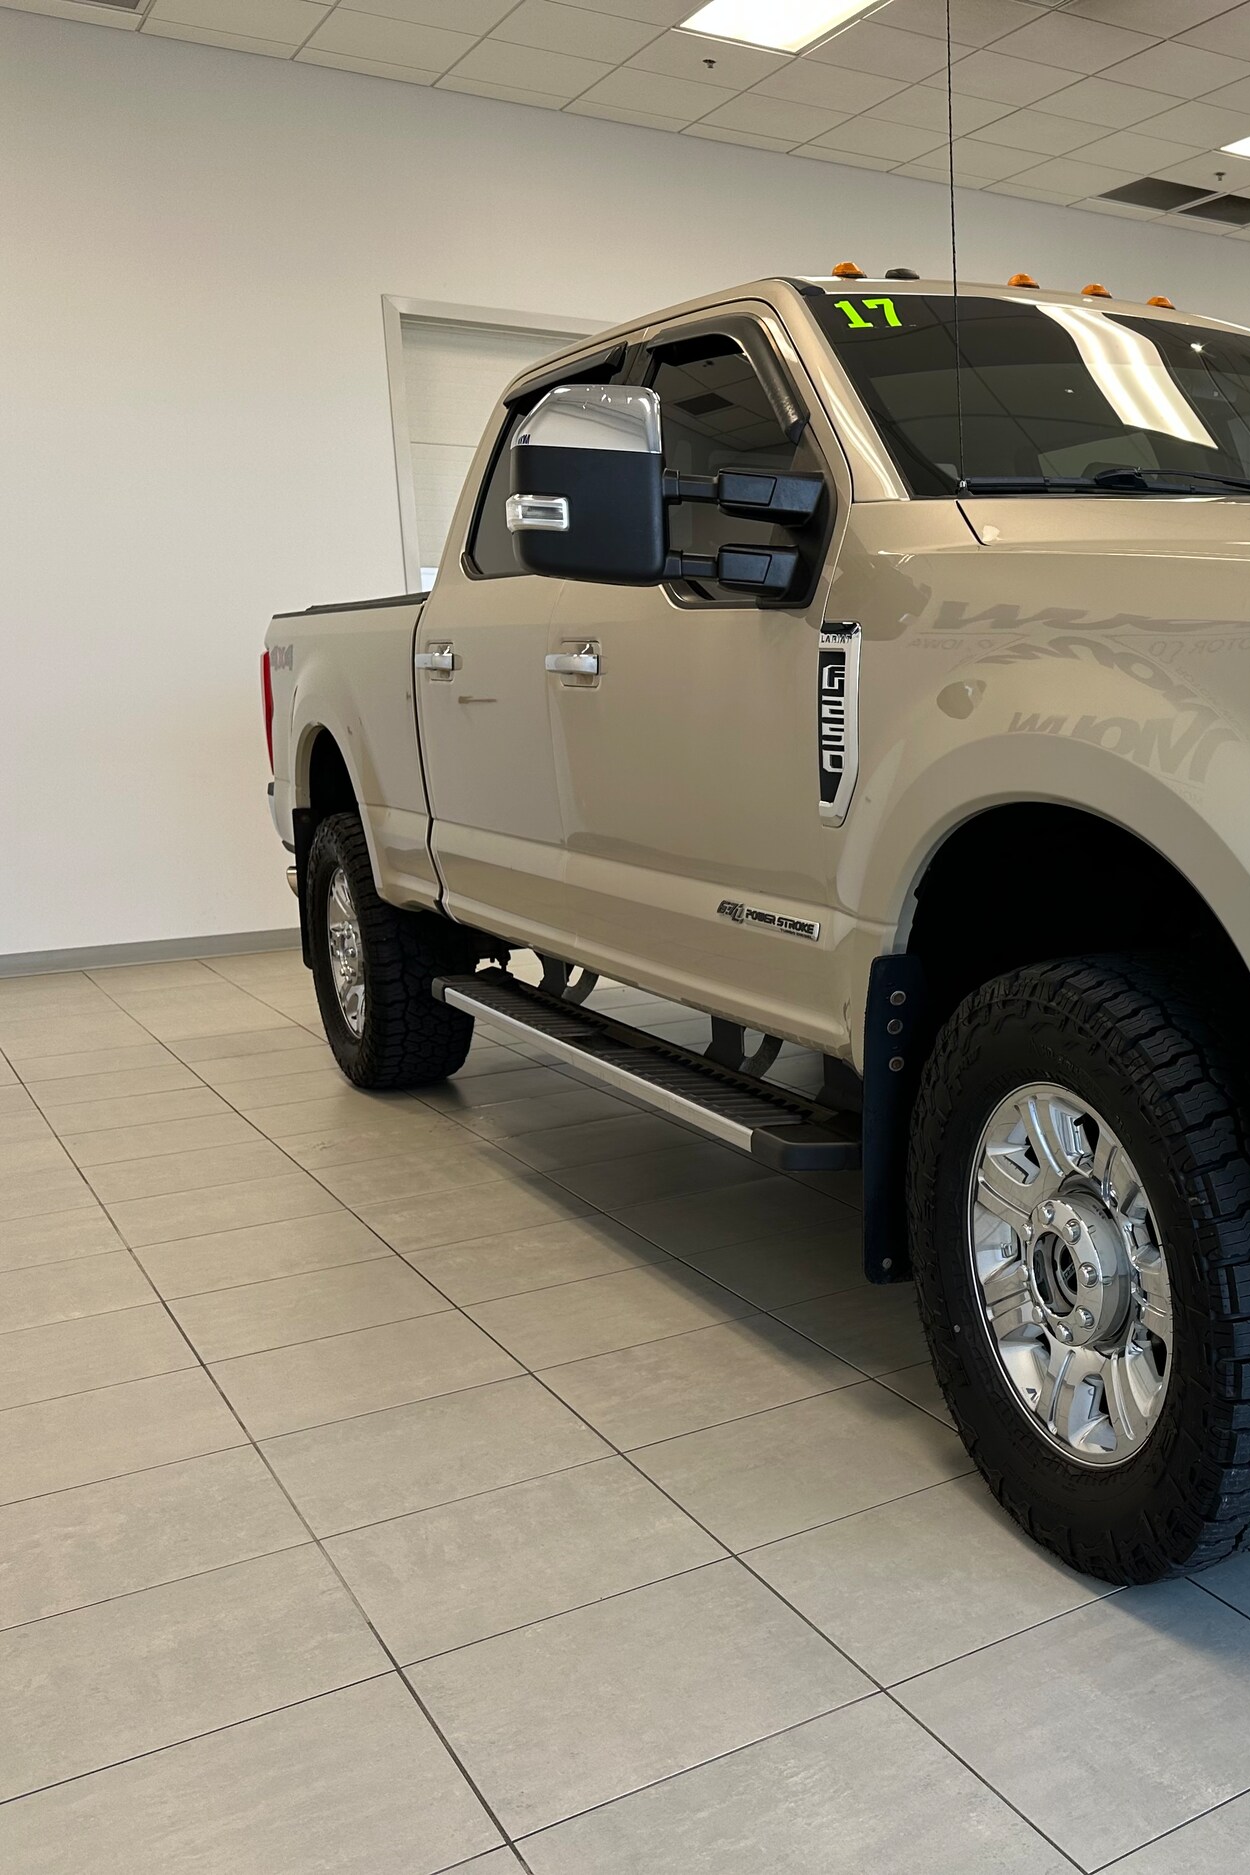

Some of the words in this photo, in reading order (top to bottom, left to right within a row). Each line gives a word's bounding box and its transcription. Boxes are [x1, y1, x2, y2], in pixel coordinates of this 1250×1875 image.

[834, 298, 902, 328] 17
[820, 633, 851, 644] LARIAT
[745, 908, 776, 926] POWER
[777, 917, 815, 935] STROKE
